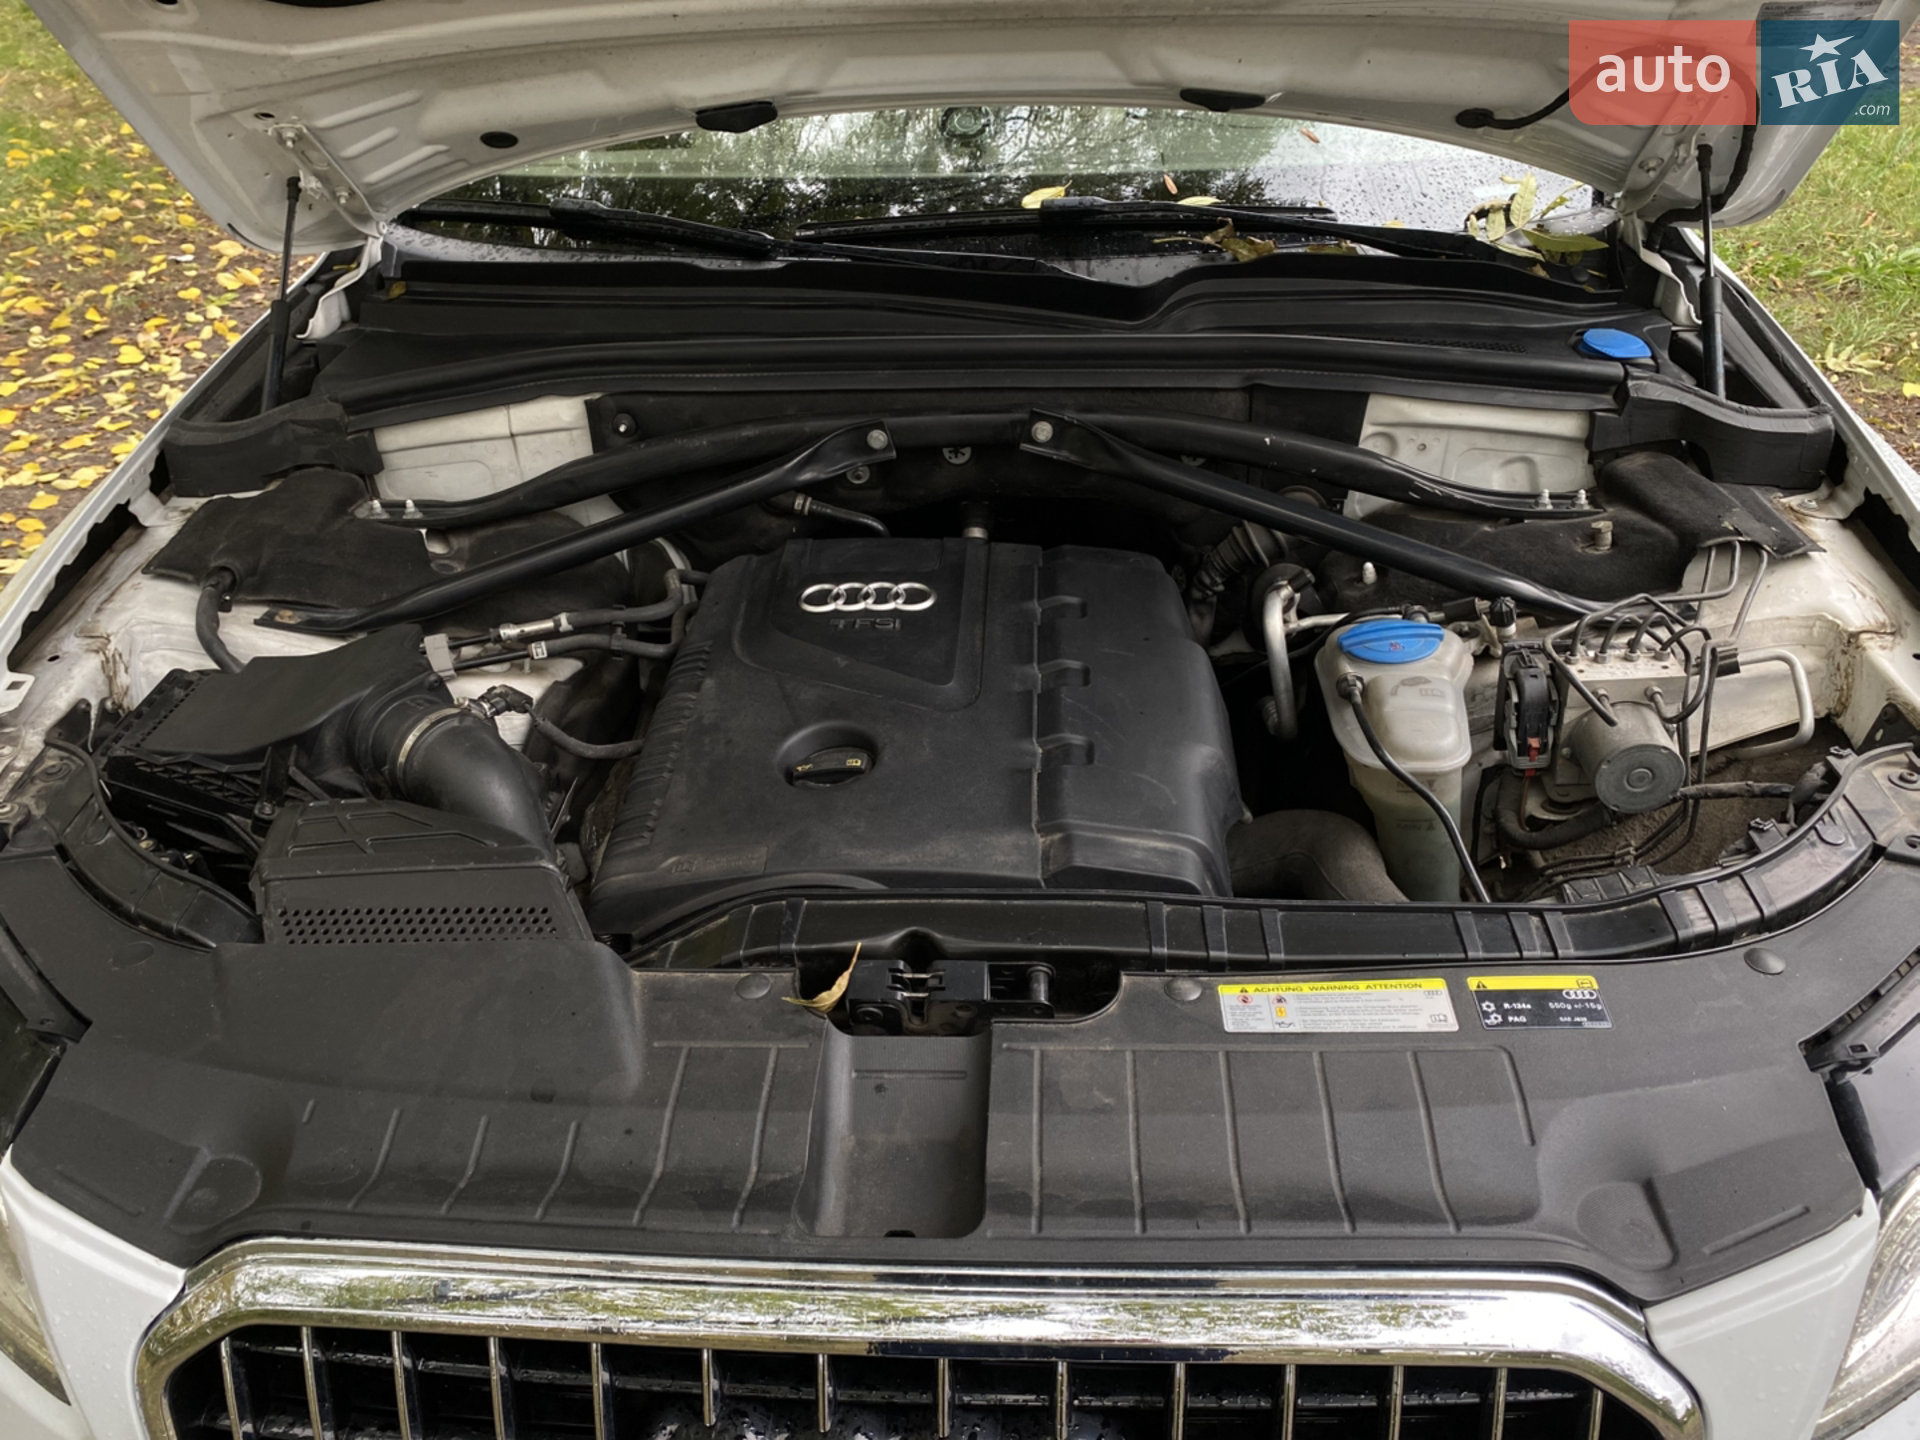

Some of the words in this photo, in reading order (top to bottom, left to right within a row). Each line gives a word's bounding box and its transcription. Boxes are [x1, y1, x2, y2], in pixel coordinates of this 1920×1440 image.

[829, 617, 902, 631] TFSI
[1253, 985, 1304, 993] ACHTUNG
[1308, 983, 1360, 992] WARNING
[1365, 982, 1423, 990] ATTENTION
[1507, 1015, 1528, 1023] PAG
